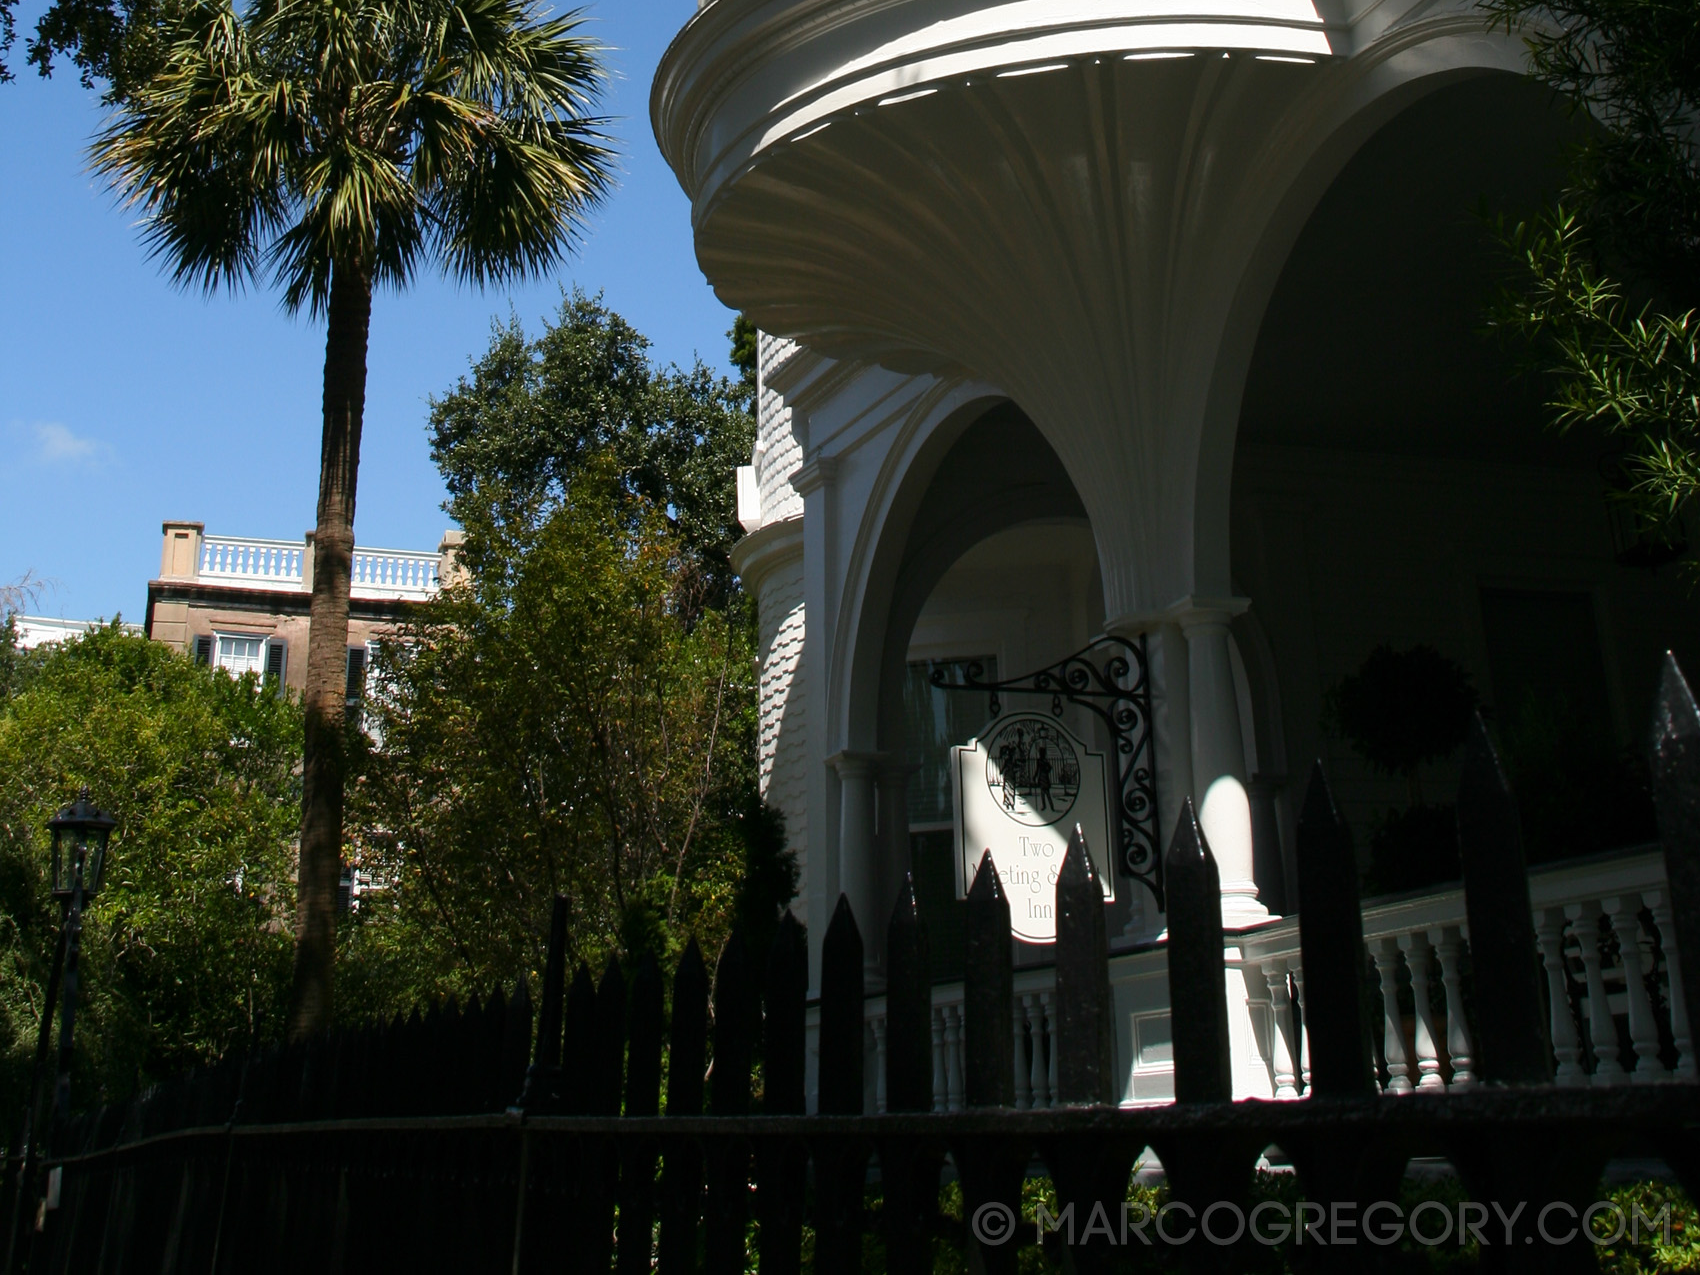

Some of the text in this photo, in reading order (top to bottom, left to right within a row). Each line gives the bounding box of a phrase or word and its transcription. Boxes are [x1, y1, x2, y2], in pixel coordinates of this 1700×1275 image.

[1018, 836, 1054, 857] Two
[971, 862, 1041, 893] eting
[1027, 898, 1053, 918] Inn
